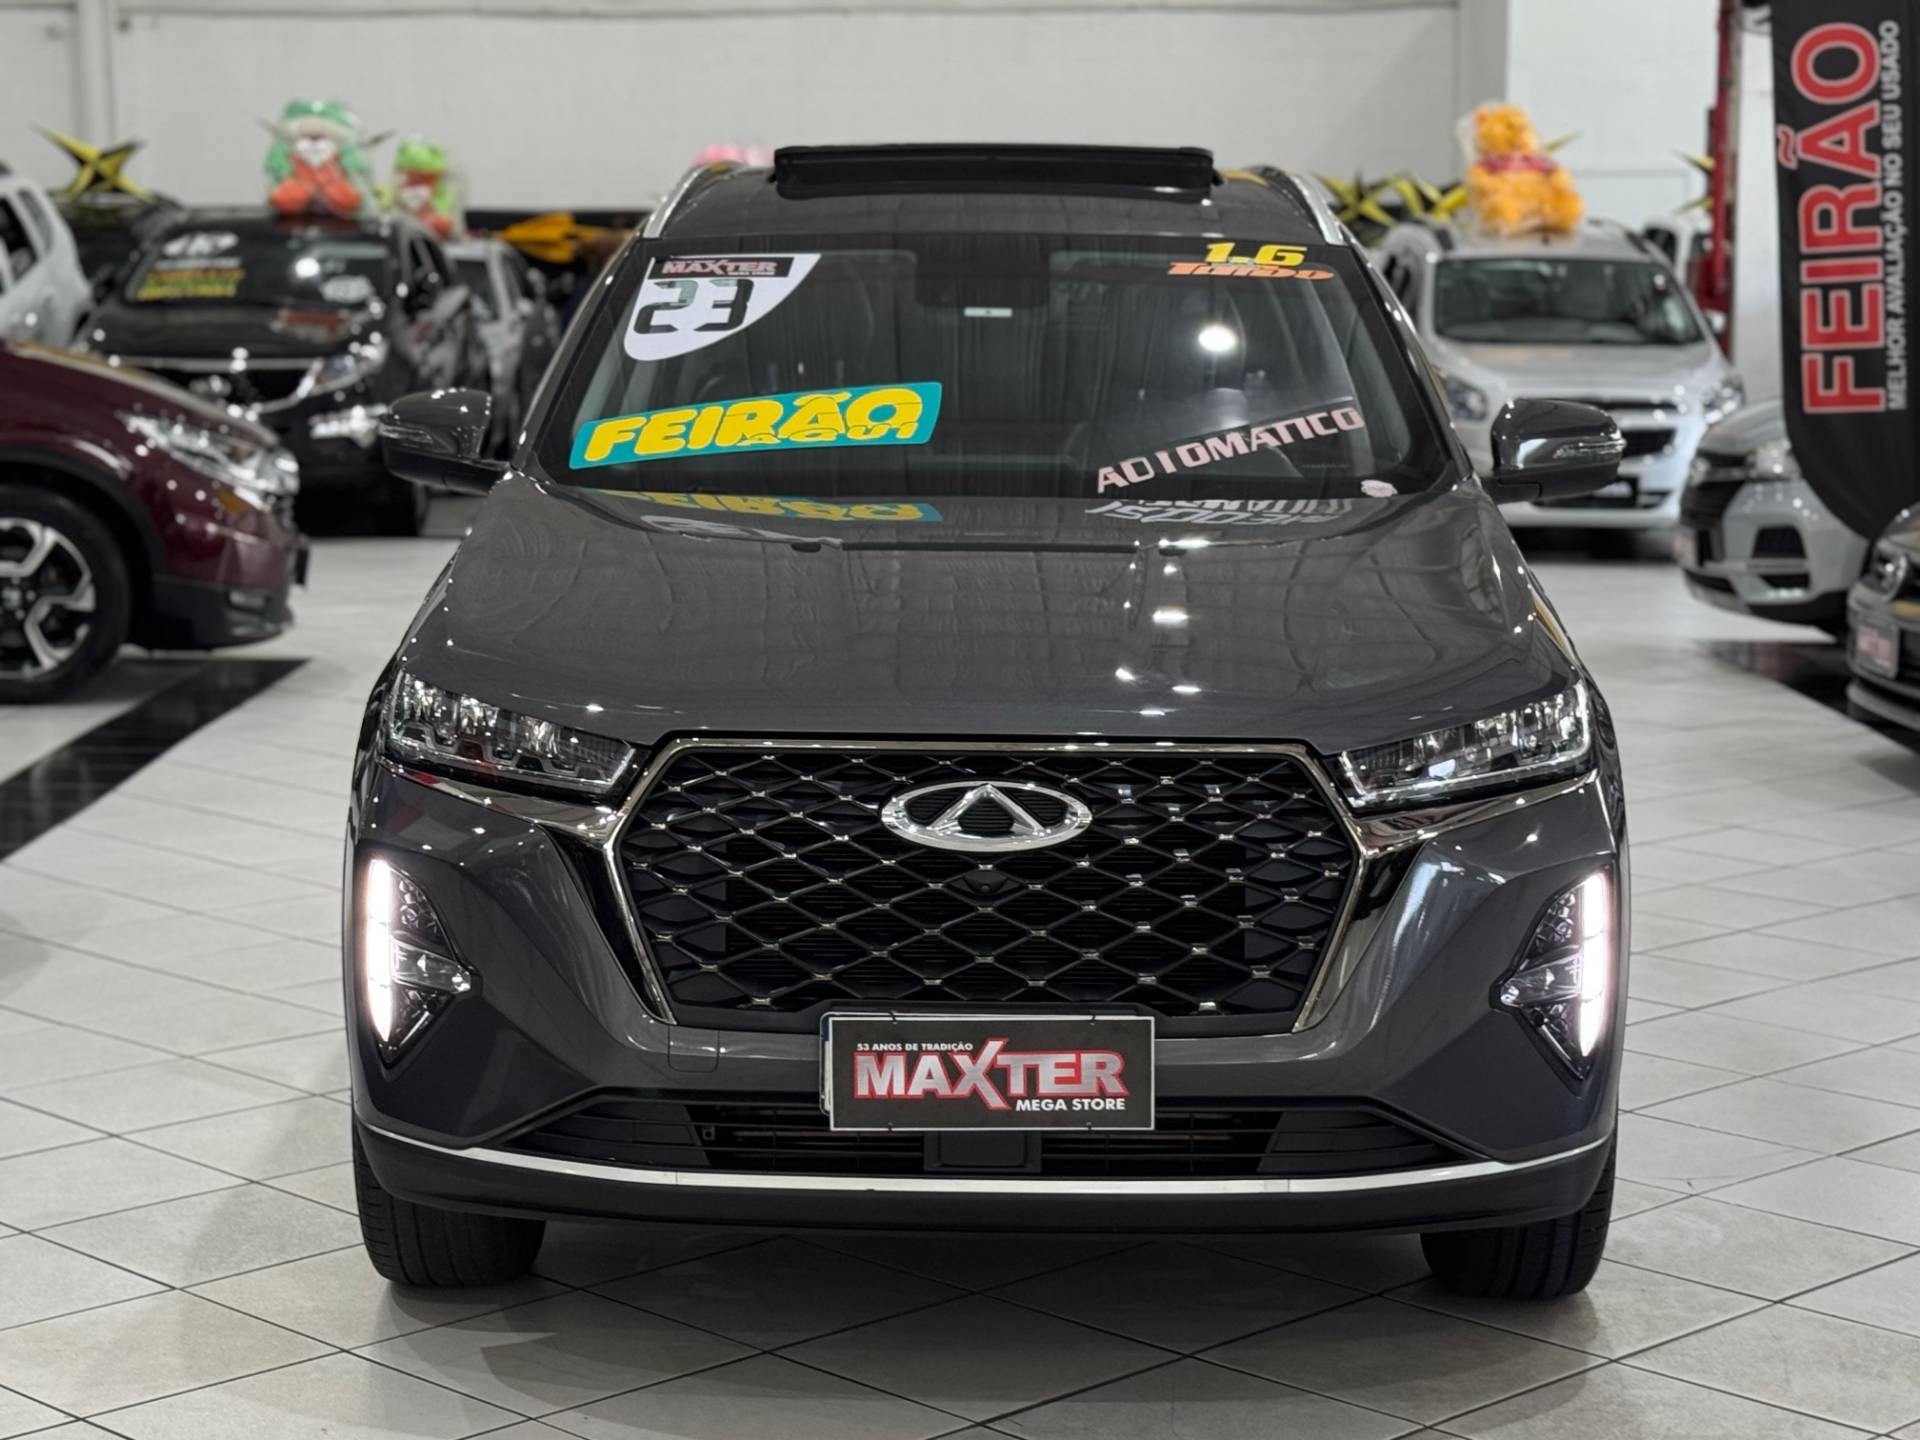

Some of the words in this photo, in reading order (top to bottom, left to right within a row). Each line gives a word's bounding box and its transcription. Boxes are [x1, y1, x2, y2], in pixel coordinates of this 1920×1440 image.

[1878, 20, 1901, 100] USADO
[1881, 104, 1903, 149] SEU
[1883, 152, 1904, 187] NO
[1777, 22, 1886, 413] FEIRÃO
[661, 258, 778, 275] MAXTER
[1205, 242, 1308, 266] 1.6
[1880, 190, 1909, 315] AVALIAÇÃO
[633, 277, 755, 334] 23
[1884, 317, 1908, 411] MELHOR
[584, 388, 923, 462] FEIRÃO
[854, 1037, 1129, 1110] MAXTER
[872, 1043, 902, 1051] ANOS
[905, 1043, 919, 1051] DE
[921, 1041, 973, 1053] TRADIÇÃO
[1015, 1099, 1067, 1111] MEGA
[1071, 1098, 1126, 1110] STORE
